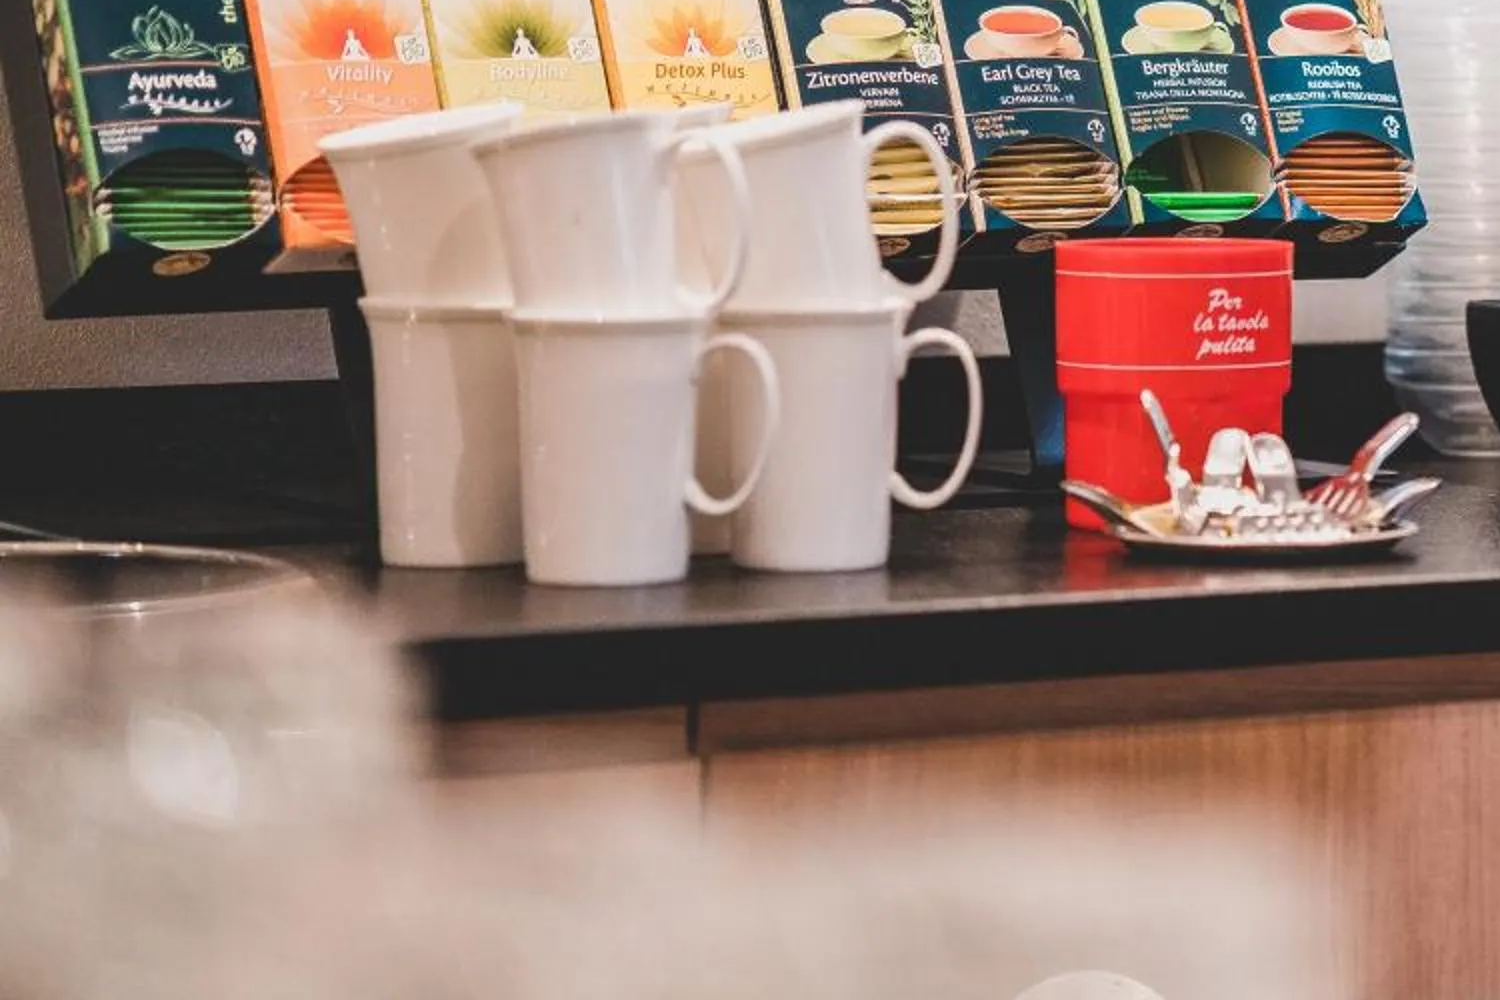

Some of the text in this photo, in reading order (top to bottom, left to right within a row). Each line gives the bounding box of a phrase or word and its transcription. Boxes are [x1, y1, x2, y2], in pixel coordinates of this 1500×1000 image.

[328, 63, 394, 85] Vitality
[656, 63, 746, 79] Detox Plus
[806, 67, 938, 88] Zitronenverbene
[982, 64, 1081, 82] Earl Grey Tea
[1141, 58, 1229, 78] Bergkräuter
[128, 69, 217, 93] Ayurveda
[1208, 288, 1243, 312] Per
[1194, 310, 1269, 334] la tavola
[1196, 335, 1256, 360] pulita
